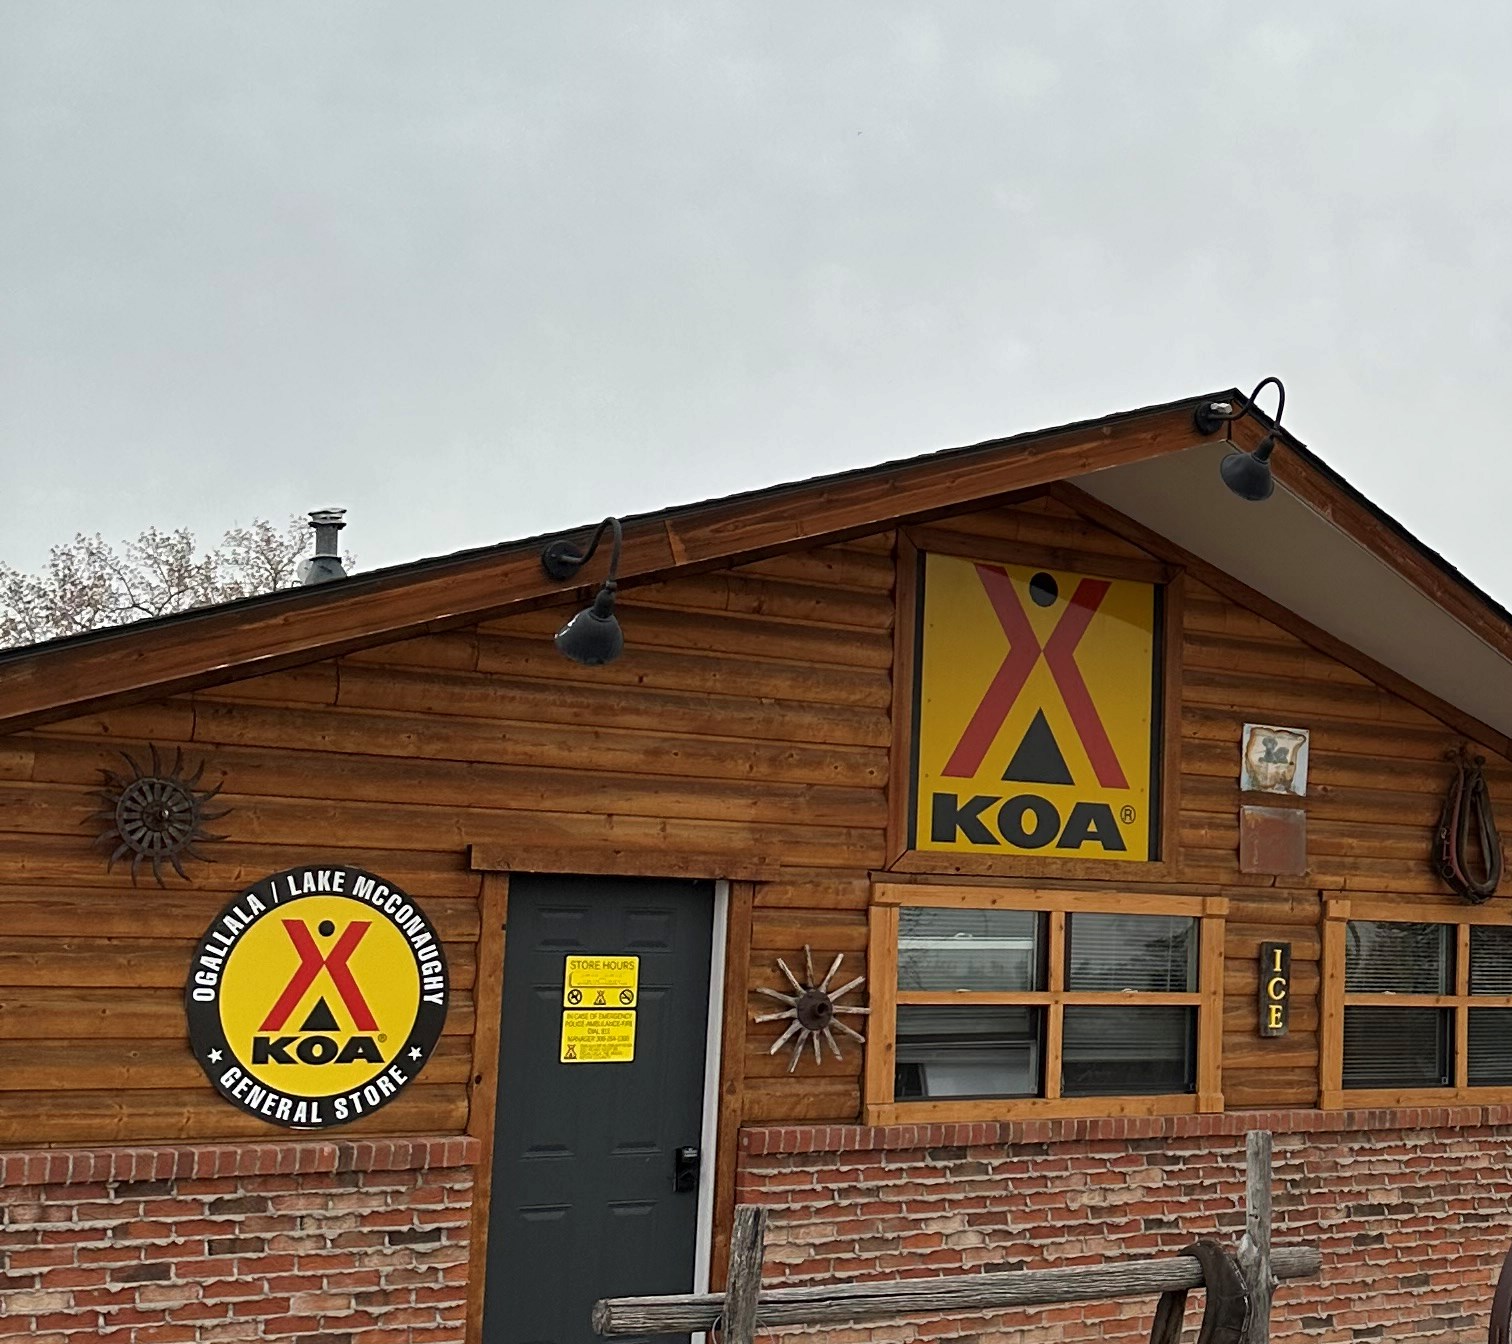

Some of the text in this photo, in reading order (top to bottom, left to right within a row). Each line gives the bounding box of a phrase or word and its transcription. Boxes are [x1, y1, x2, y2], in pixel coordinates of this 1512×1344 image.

[931, 792, 1127, 852] KOA
[192, 893, 267, 1002] OGALLALA
[286, 870, 346, 896] LAKE
[352, 875, 444, 1006] MCCONAUGHY
[570, 960, 635, 970] STORE HOURS
[1267, 949, 1287, 1029] ICE
[251, 1035, 386, 1065] KOA
[219, 1064, 408, 1123] GENERAL STORE
